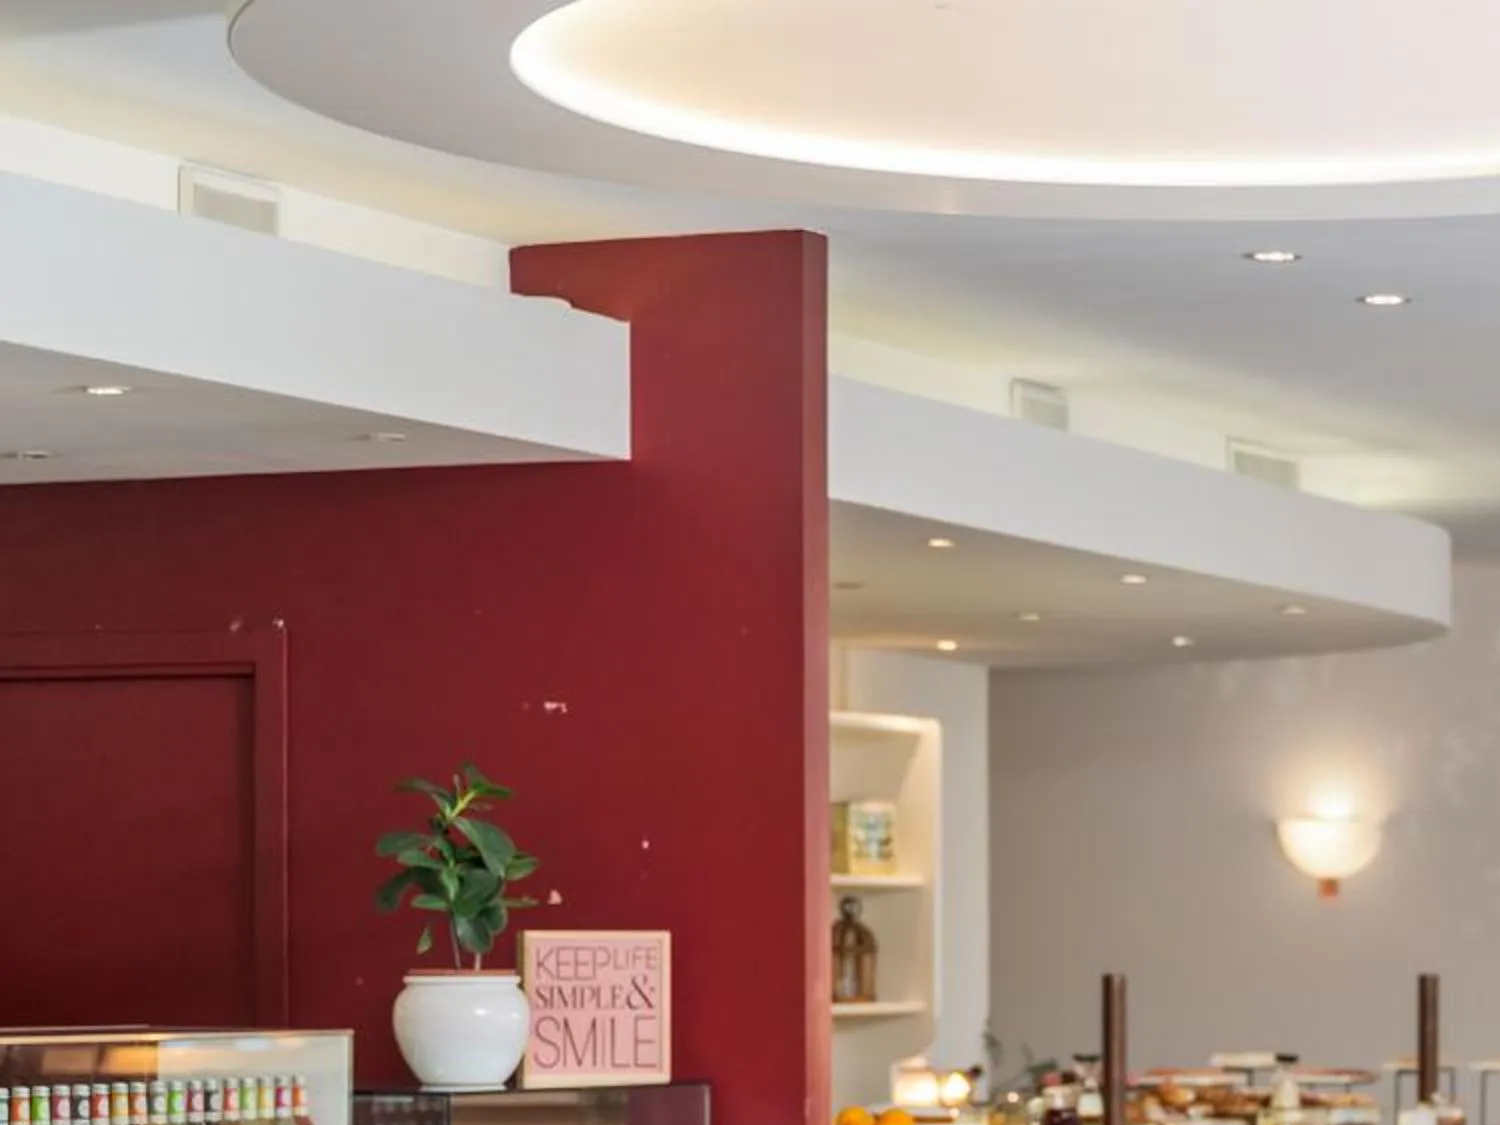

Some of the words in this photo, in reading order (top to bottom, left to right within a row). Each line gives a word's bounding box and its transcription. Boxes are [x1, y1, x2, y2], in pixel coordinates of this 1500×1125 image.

[535, 946, 611, 981] KEEP
[613, 946, 657, 970] LIFE
[535, 985, 626, 1009] SIMPLE
[533, 1015, 657, 1069] SMILE
